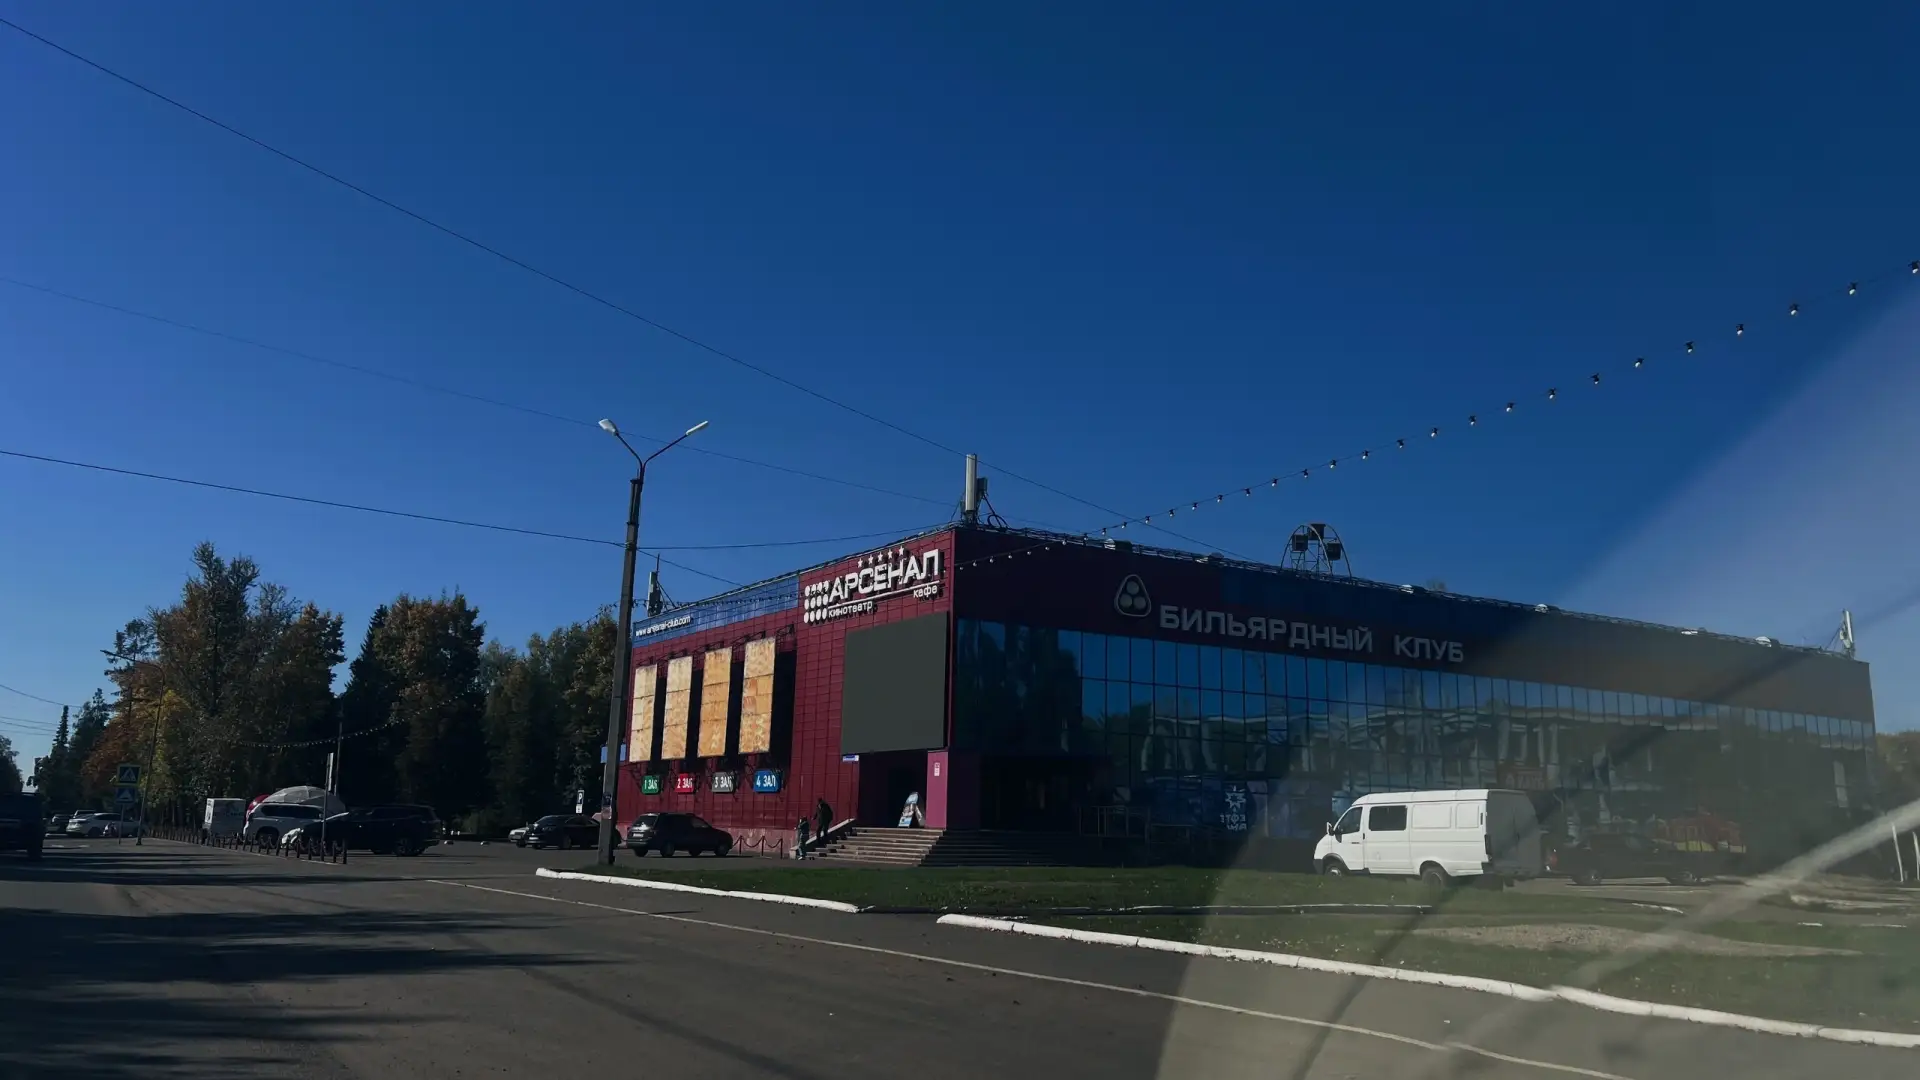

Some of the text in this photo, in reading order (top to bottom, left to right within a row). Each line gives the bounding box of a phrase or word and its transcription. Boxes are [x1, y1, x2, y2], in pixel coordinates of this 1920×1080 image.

[829, 549, 939, 602] АРСЕНАЛ
[913, 584, 937, 598] кафе
[828, 601, 873, 618] кинотеатр
[1159, 604, 1465, 663] БИЛЬЯРДНЫЙ КЛУБ
